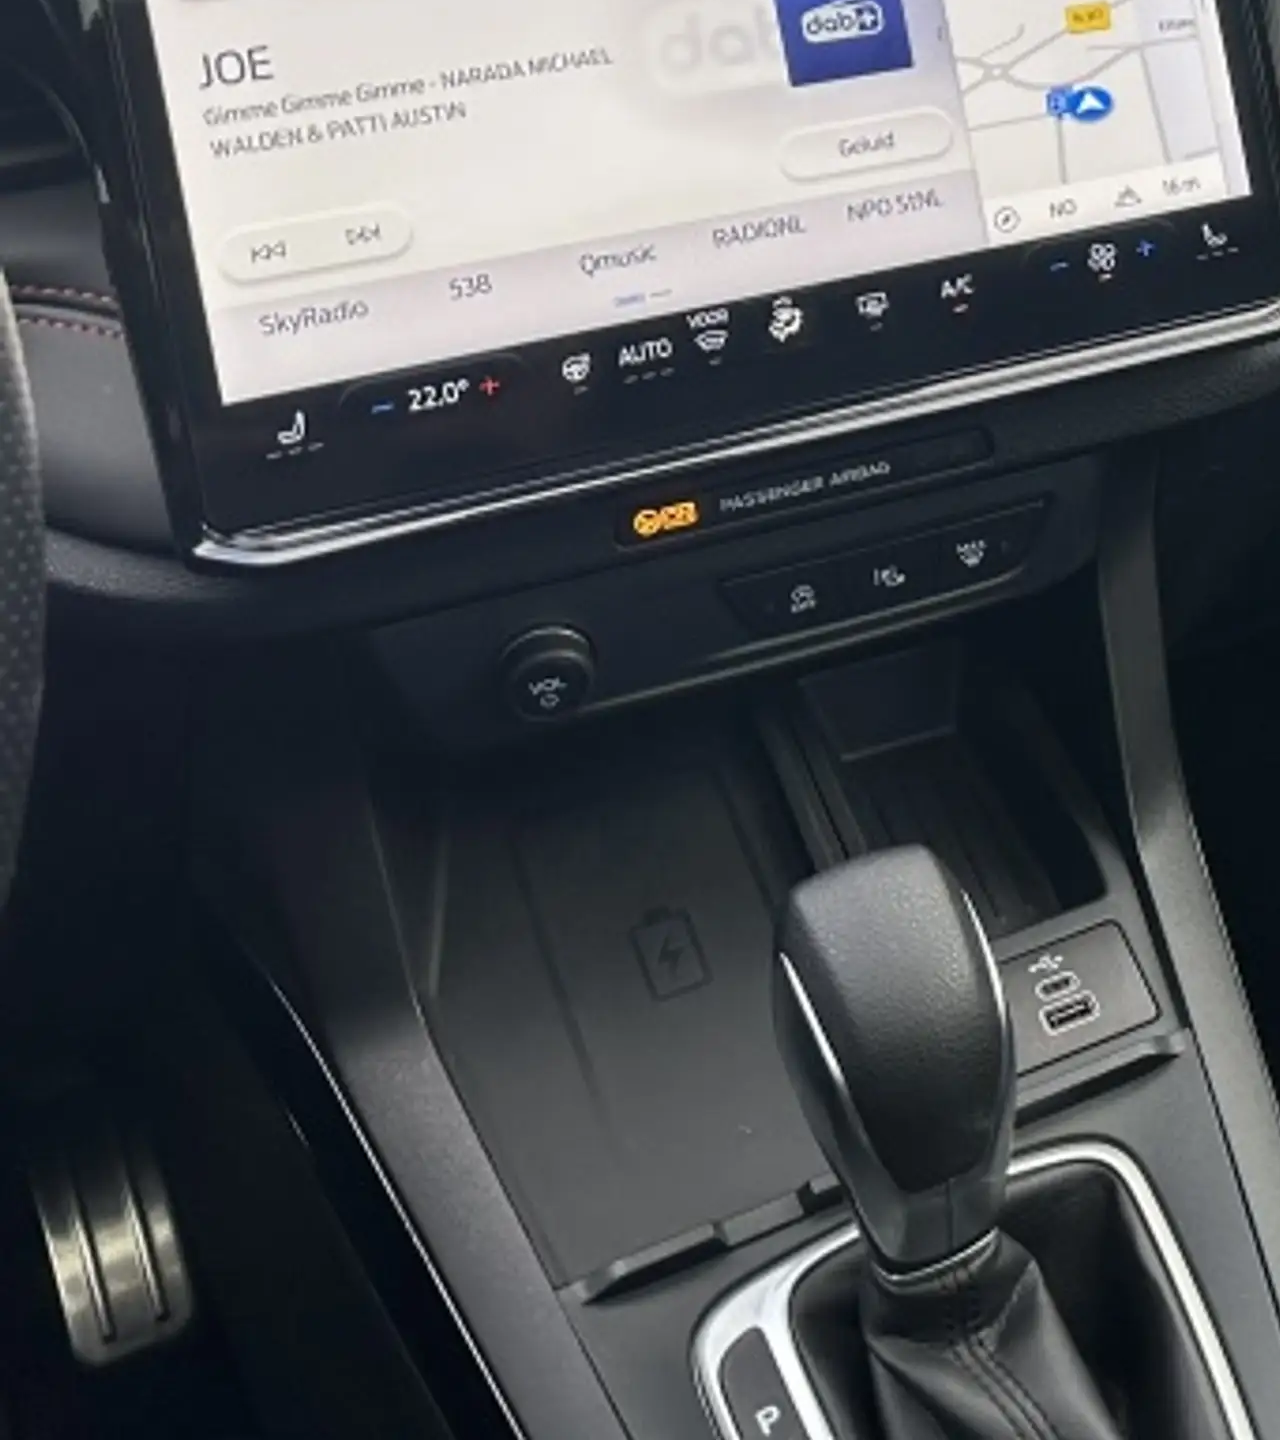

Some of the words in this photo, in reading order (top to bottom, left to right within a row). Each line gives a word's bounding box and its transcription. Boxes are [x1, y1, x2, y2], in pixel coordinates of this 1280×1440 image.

[198, 44, 275, 90] JOE
[202, 101, 278, 126] Gimme
[281, 89, 352, 115] Gimme
[355, 77, 425, 103] Gimme
[439, 59, 527, 90] NARADA
[528, 46, 614, 75] MICHAEL
[209, 126, 304, 159] WALDEN
[307, 123, 324, 144] &
[326, 111, 389, 141] PATTI
[390, 100, 467, 131] AUSTIN
[839, 132, 895, 158] Geluid
[846, 195, 894, 222] NPO
[578, 243, 658, 278] Qmusic
[449, 273, 493, 301] 538
[940, 273, 974, 299] A/C
[258, 298, 370, 338] SkyRadio
[685, 307, 730, 330] VOOR
[618, 337, 673, 367] AUTO
[719, 475, 824, 512] PASSENGER
[828, 461, 892, 488] AIRBAG
[527, 676, 569, 697] VOL
[754, 1404, 782, 1438] P
